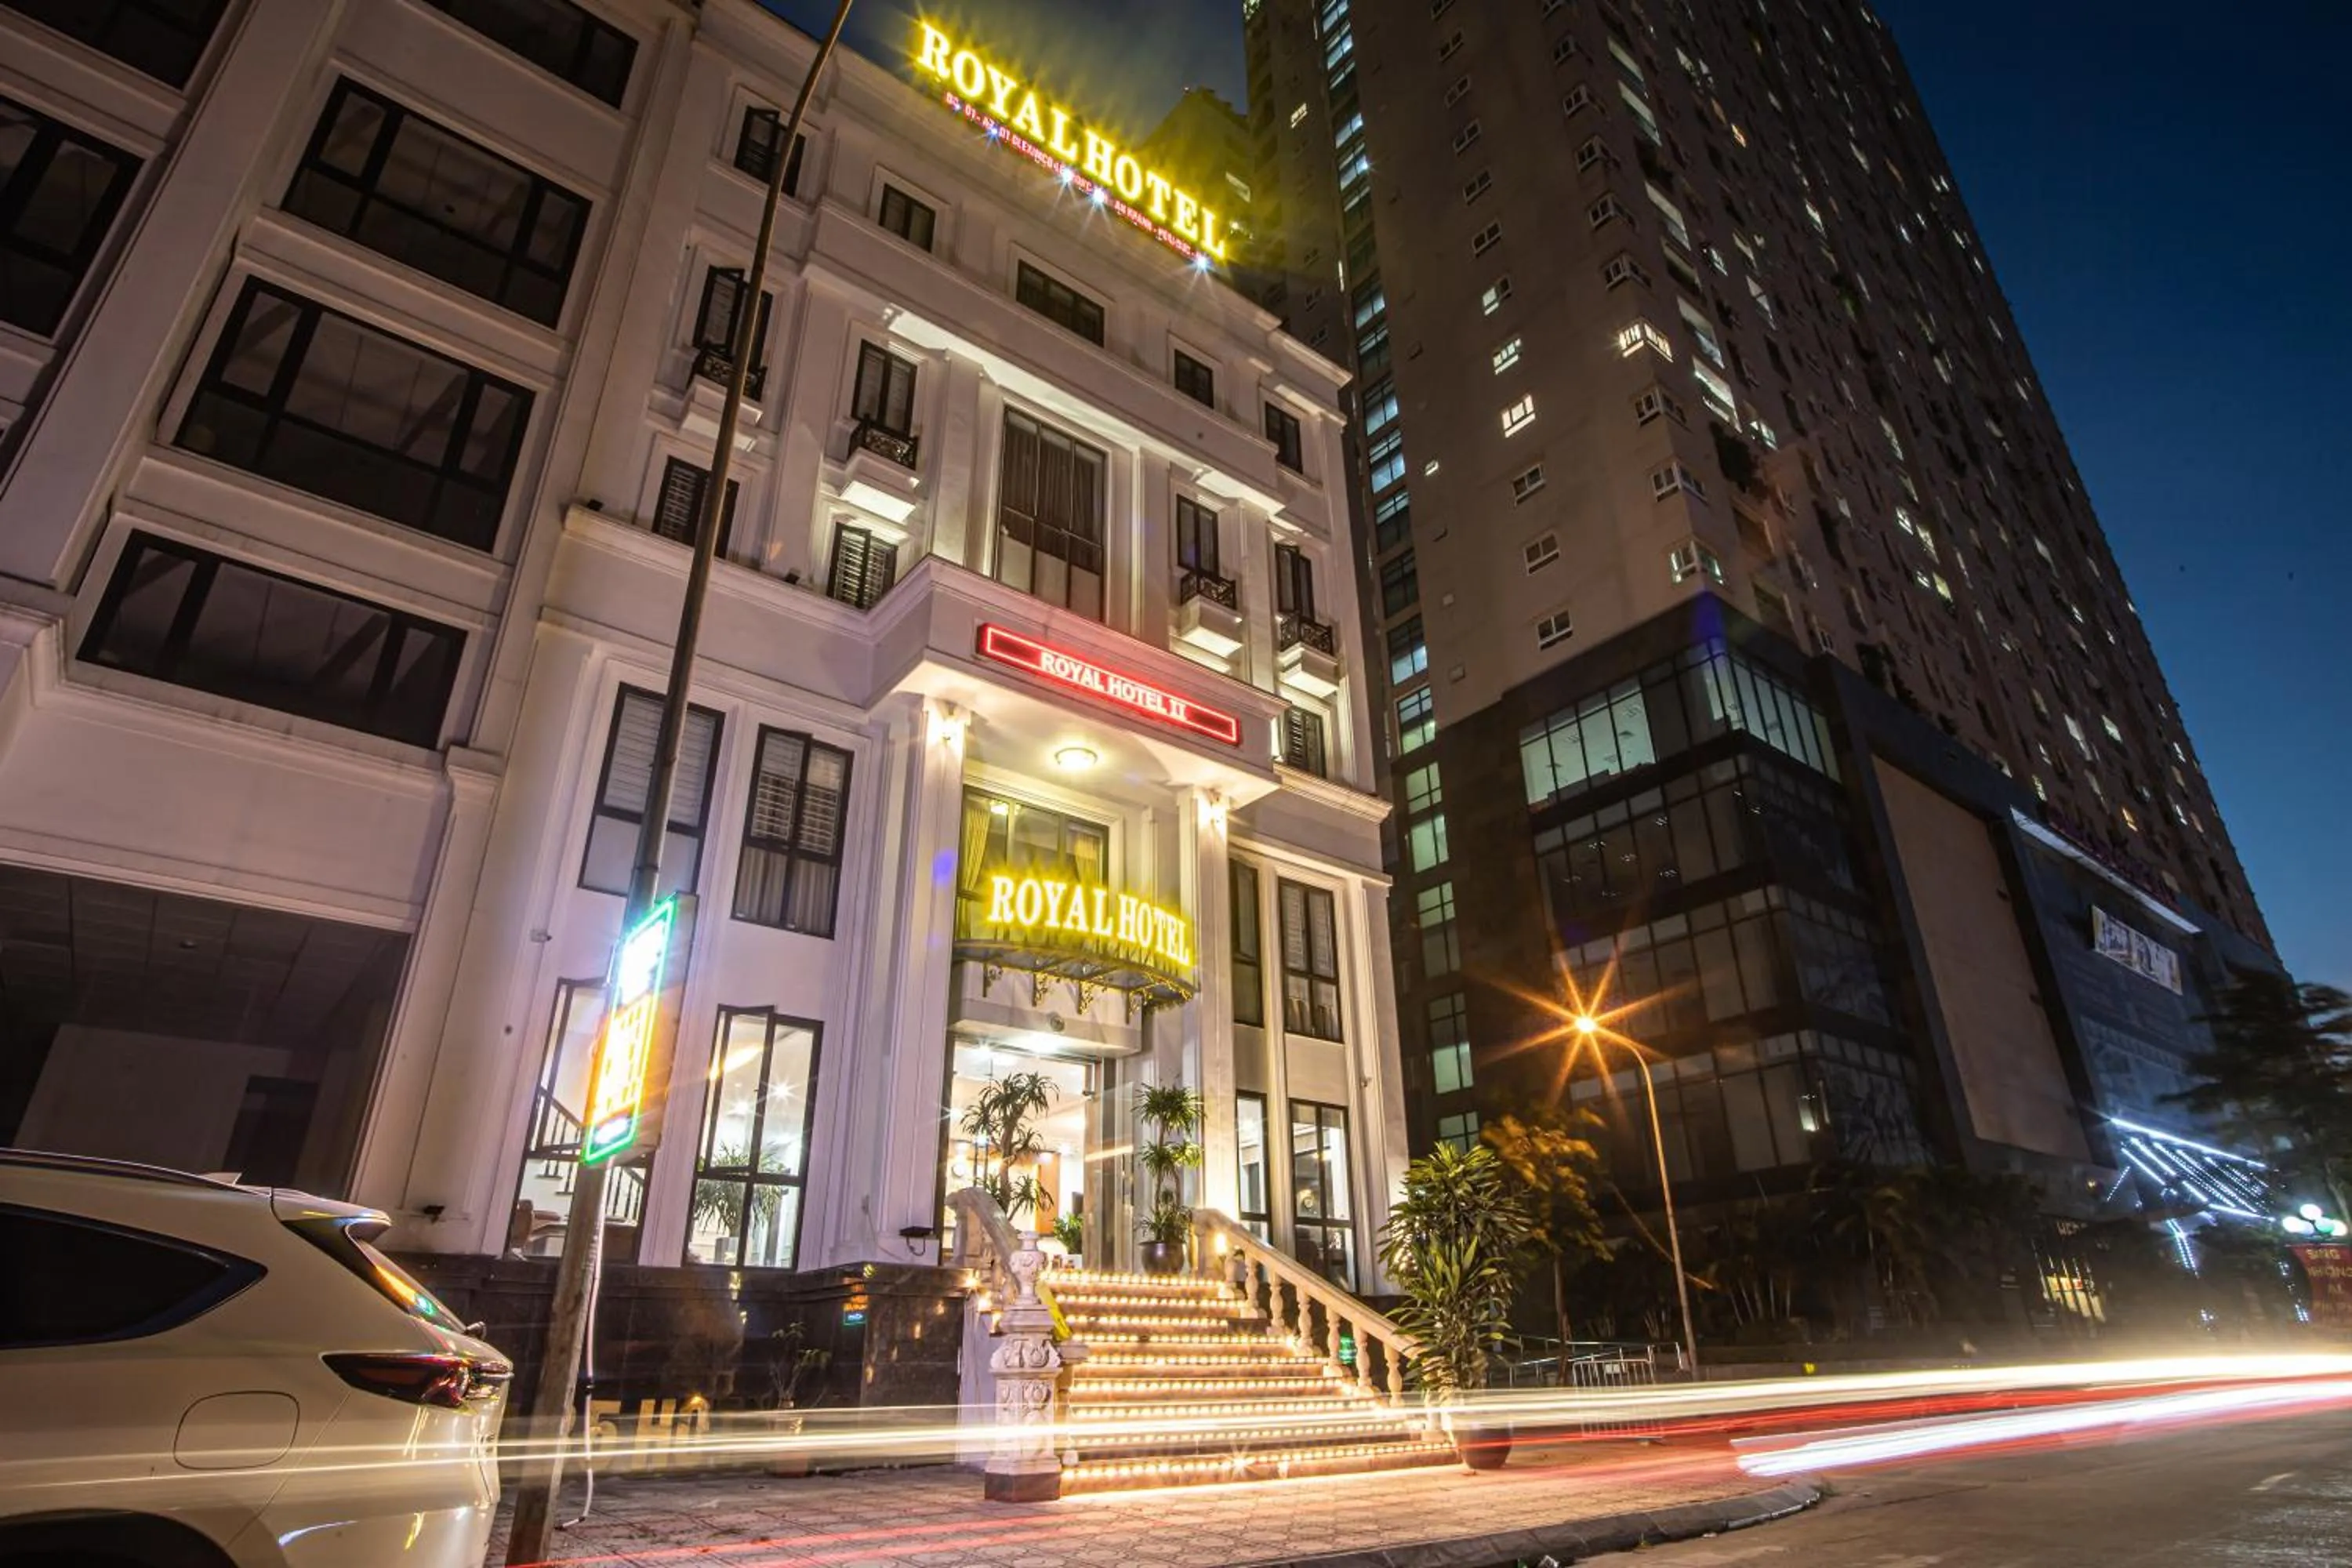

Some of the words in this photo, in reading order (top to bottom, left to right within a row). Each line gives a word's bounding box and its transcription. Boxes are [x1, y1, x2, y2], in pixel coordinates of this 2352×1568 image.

[917, 23, 1078, 162] ROYAL
[1083, 128, 1225, 260] HOTEL
[1040, 651, 1105, 690] ROYAL
[1108, 677, 1166, 714] HOTEL
[1170, 696, 1187, 720] II
[989, 876, 1113, 936] ROYAL
[1117, 893, 1190, 965] HOTEL
